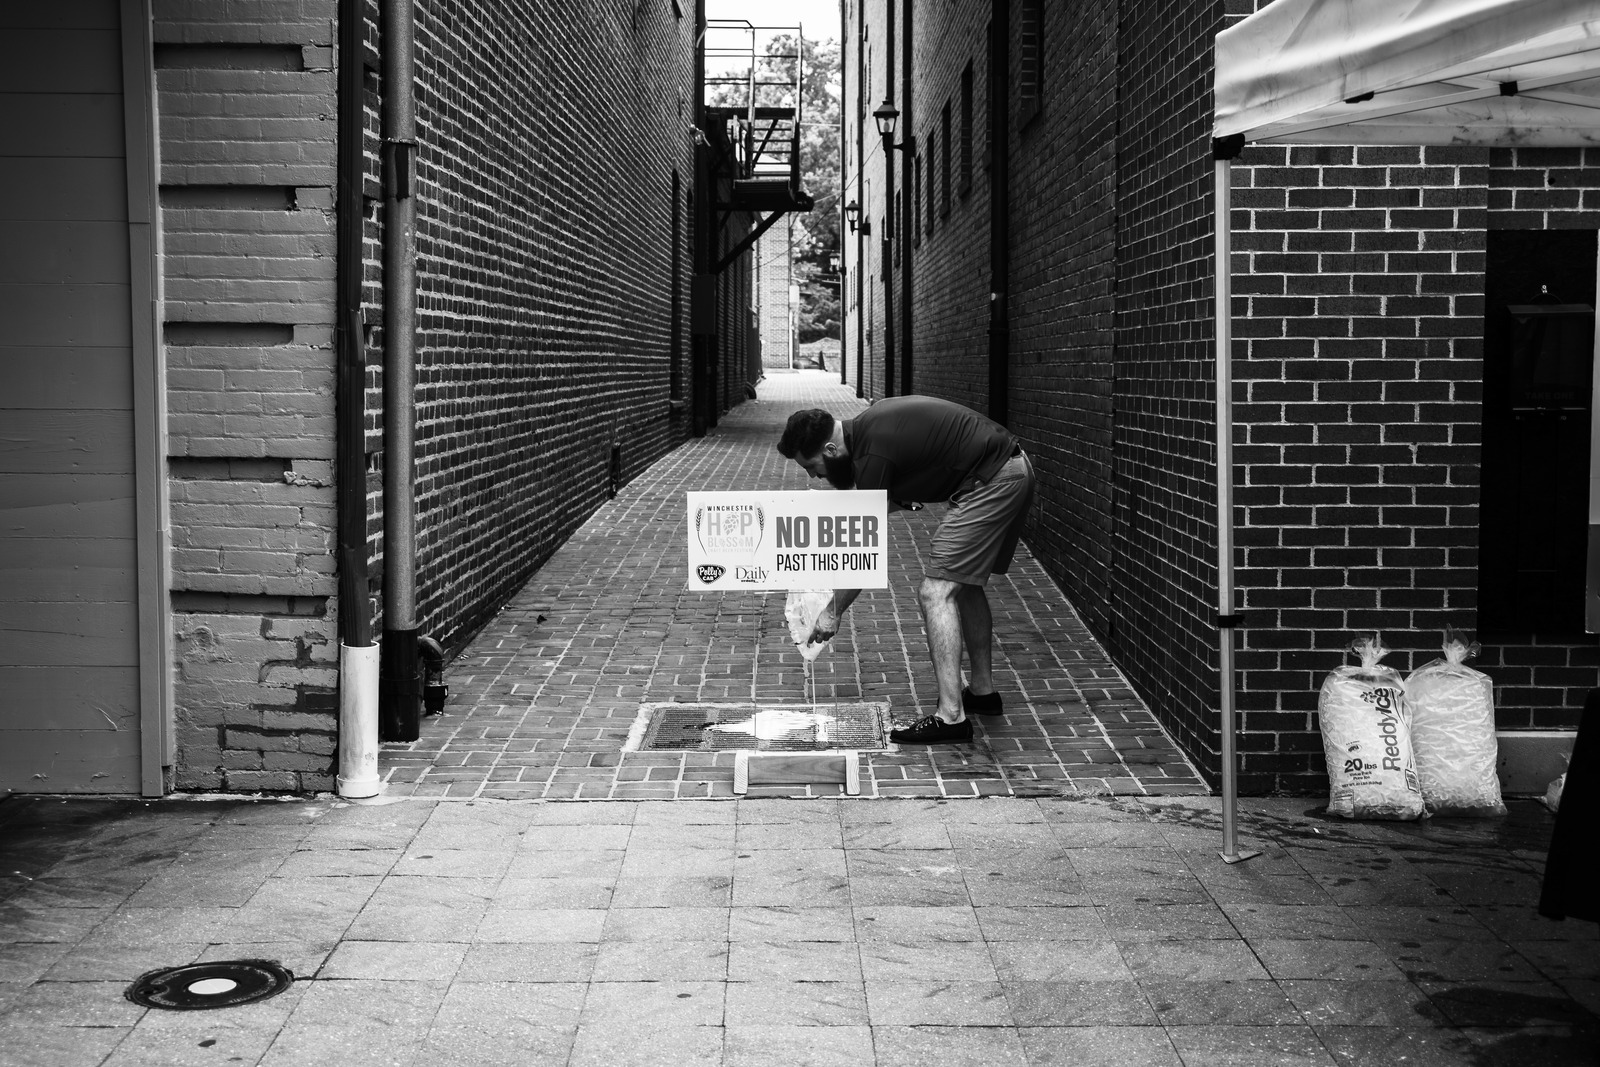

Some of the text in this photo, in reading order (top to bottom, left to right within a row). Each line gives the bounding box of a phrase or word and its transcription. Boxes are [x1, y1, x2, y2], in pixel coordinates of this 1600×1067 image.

[1525, 391, 1575, 400] TAKE ONE
[776, 515, 879, 548] NO BEER
[776, 553, 879, 571] PAST THIS POINT
[735, 566, 770, 583] Daily
[1344, 758, 1363, 773] 20
